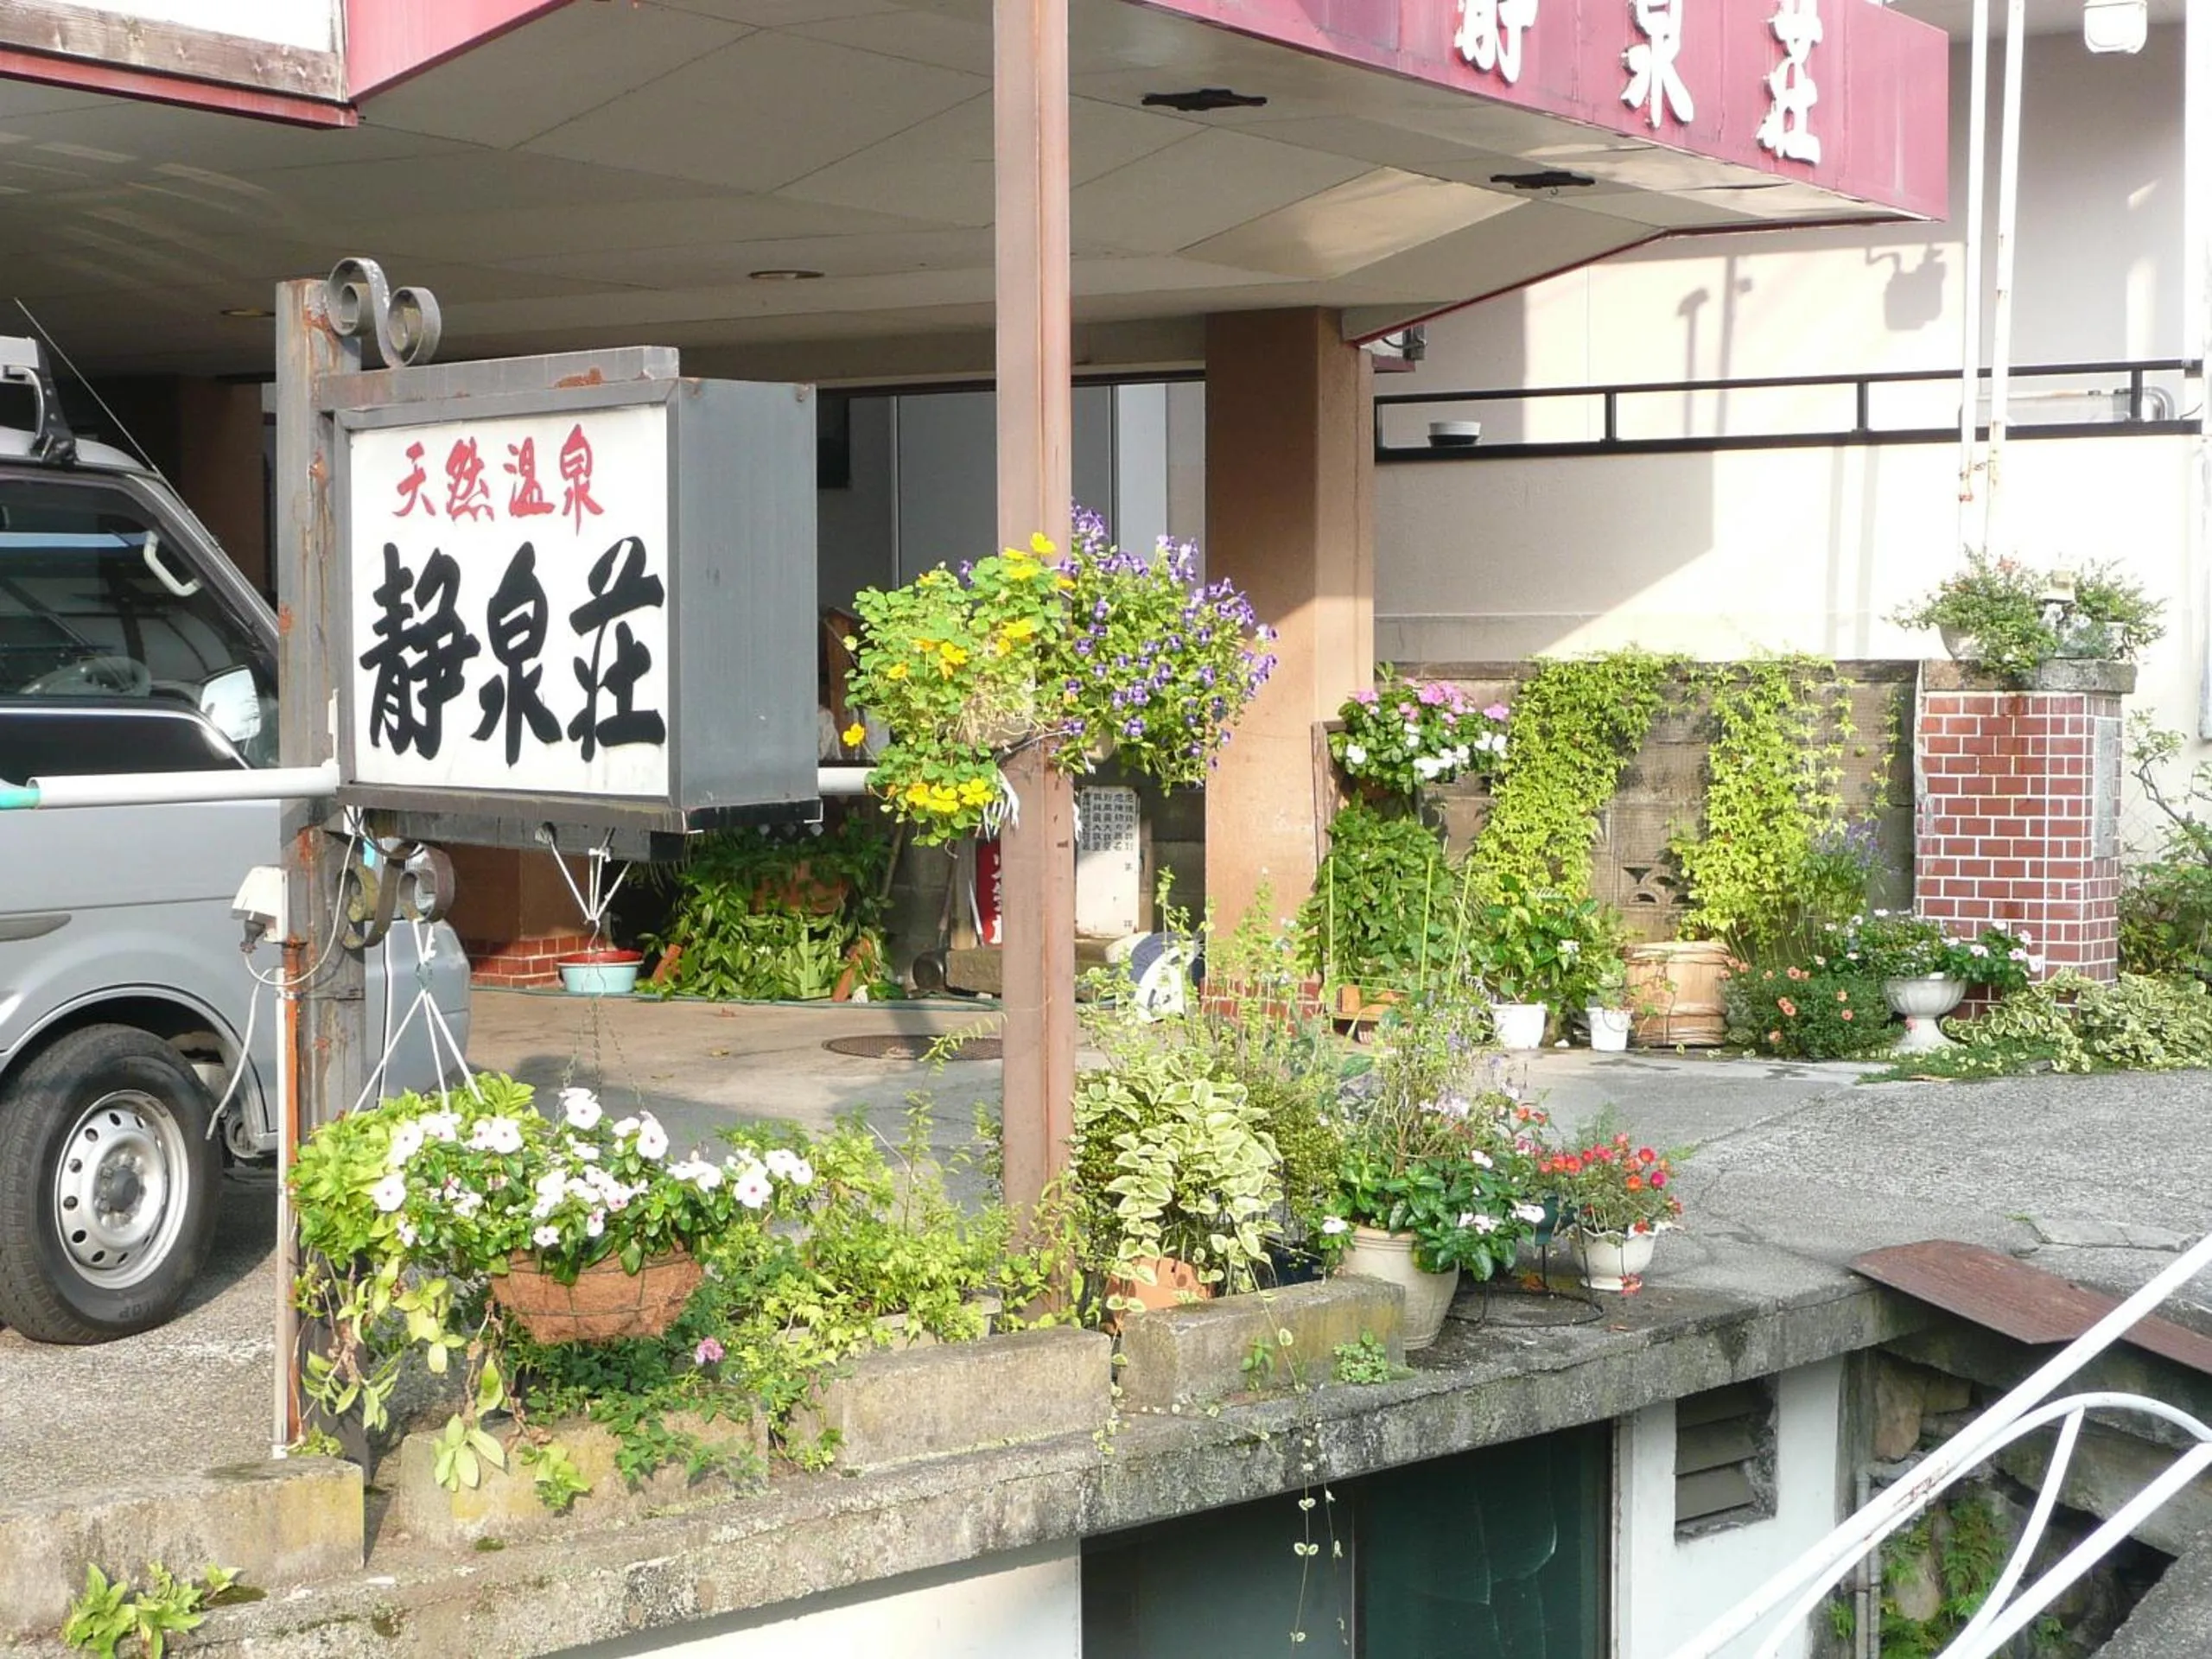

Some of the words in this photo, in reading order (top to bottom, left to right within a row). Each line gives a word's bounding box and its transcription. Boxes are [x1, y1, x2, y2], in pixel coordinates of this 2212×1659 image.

[392, 423, 605, 537] 天然温泉
[359, 535, 666, 768] 静泉荘
